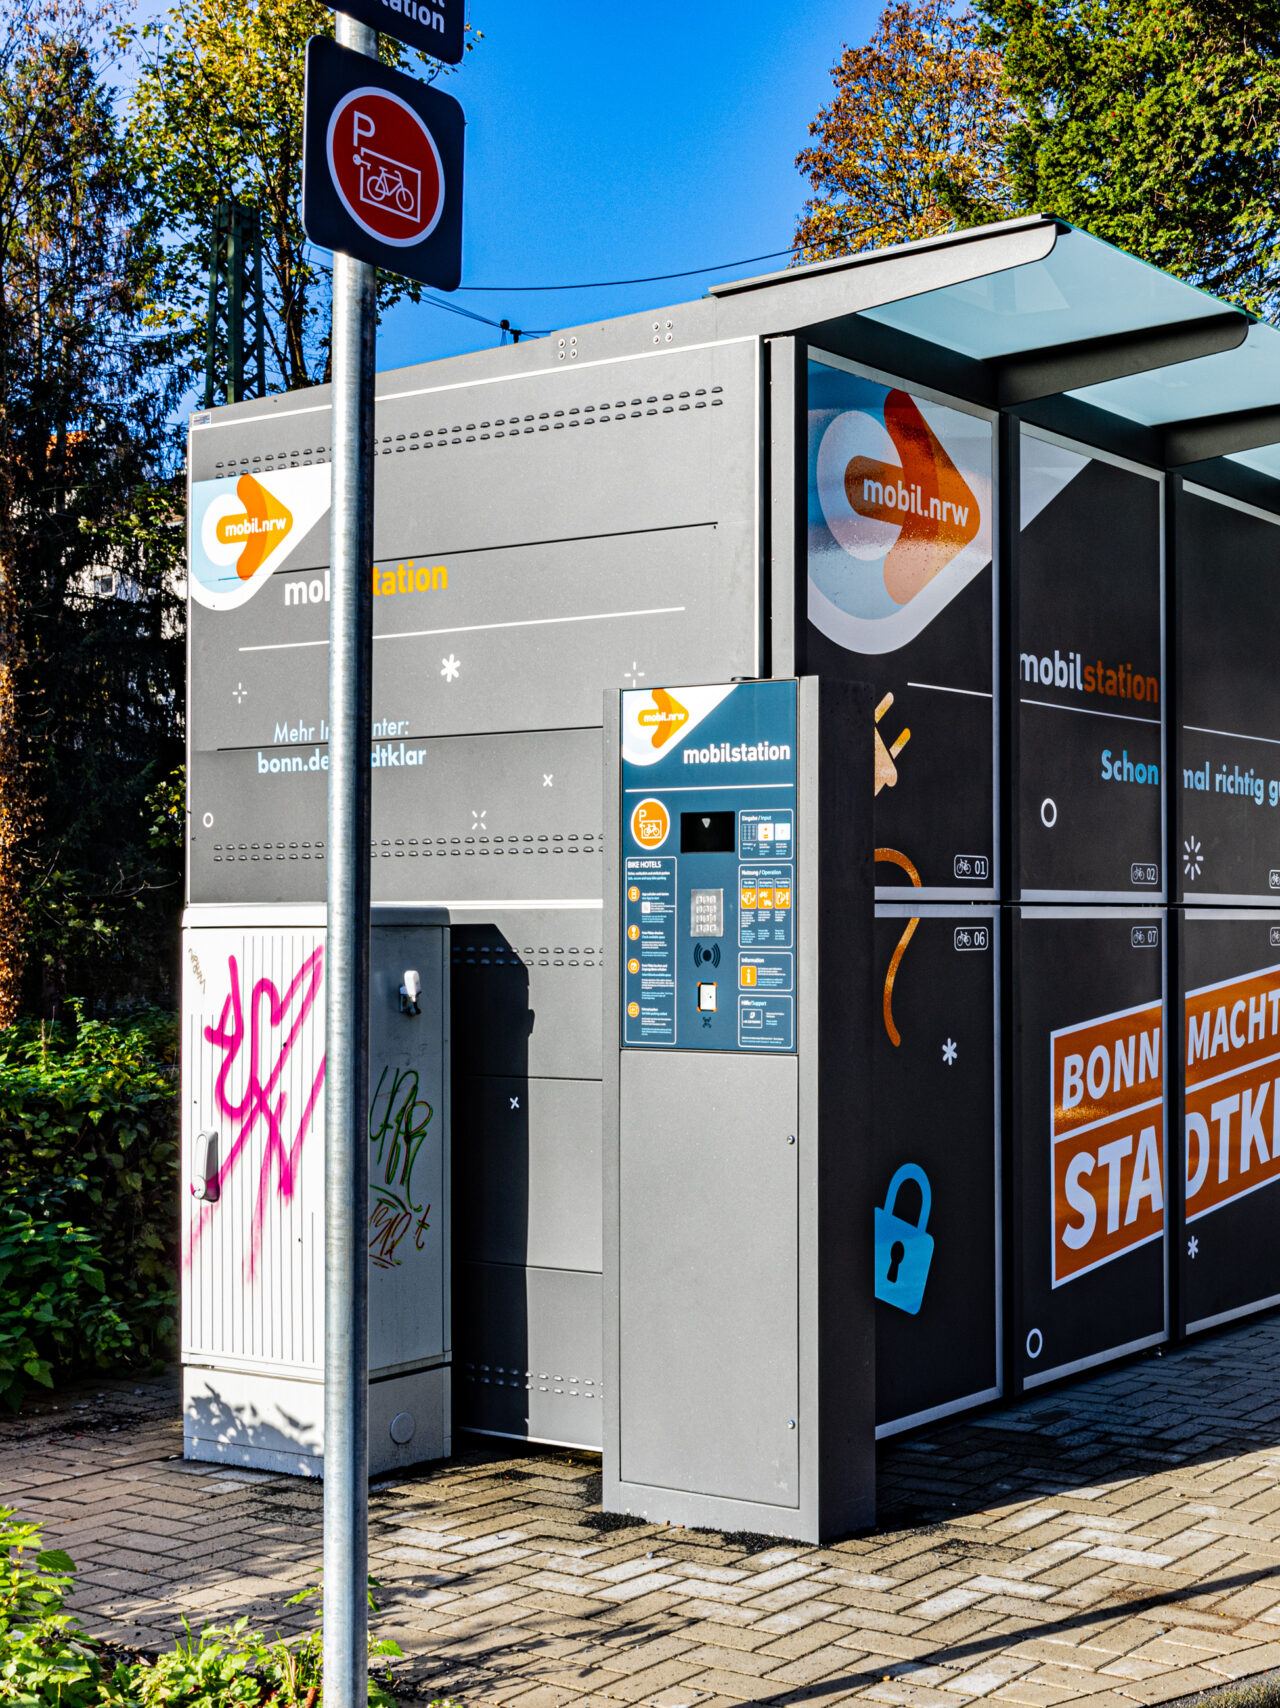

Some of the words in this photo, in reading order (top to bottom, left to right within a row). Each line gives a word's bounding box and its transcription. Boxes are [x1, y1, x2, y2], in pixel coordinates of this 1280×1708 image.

[352, 110, 376, 147] P
[863, 477, 969, 527] mobil.nrw
[225, 517, 287, 537] mobil.nrw
[1020, 650, 1159, 703] mobilstation
[643, 711, 685, 722] mobil.nrw
[273, 720, 315, 744] Mehr
[373, 718, 409, 737] nter:
[683, 741, 791, 764] mobilstation
[1101, 749, 1159, 785] Schon
[1215, 764, 1264, 805] richtig
[638, 809, 647, 822] P
[641, 861, 662, 869] HOTELS
[974, 860, 986, 876] 01
[1146, 867, 1156, 881] 02
[973, 930, 985, 946] 06
[1147, 929, 1157, 944] 07
[1062, 1027, 1160, 1111] BONN
